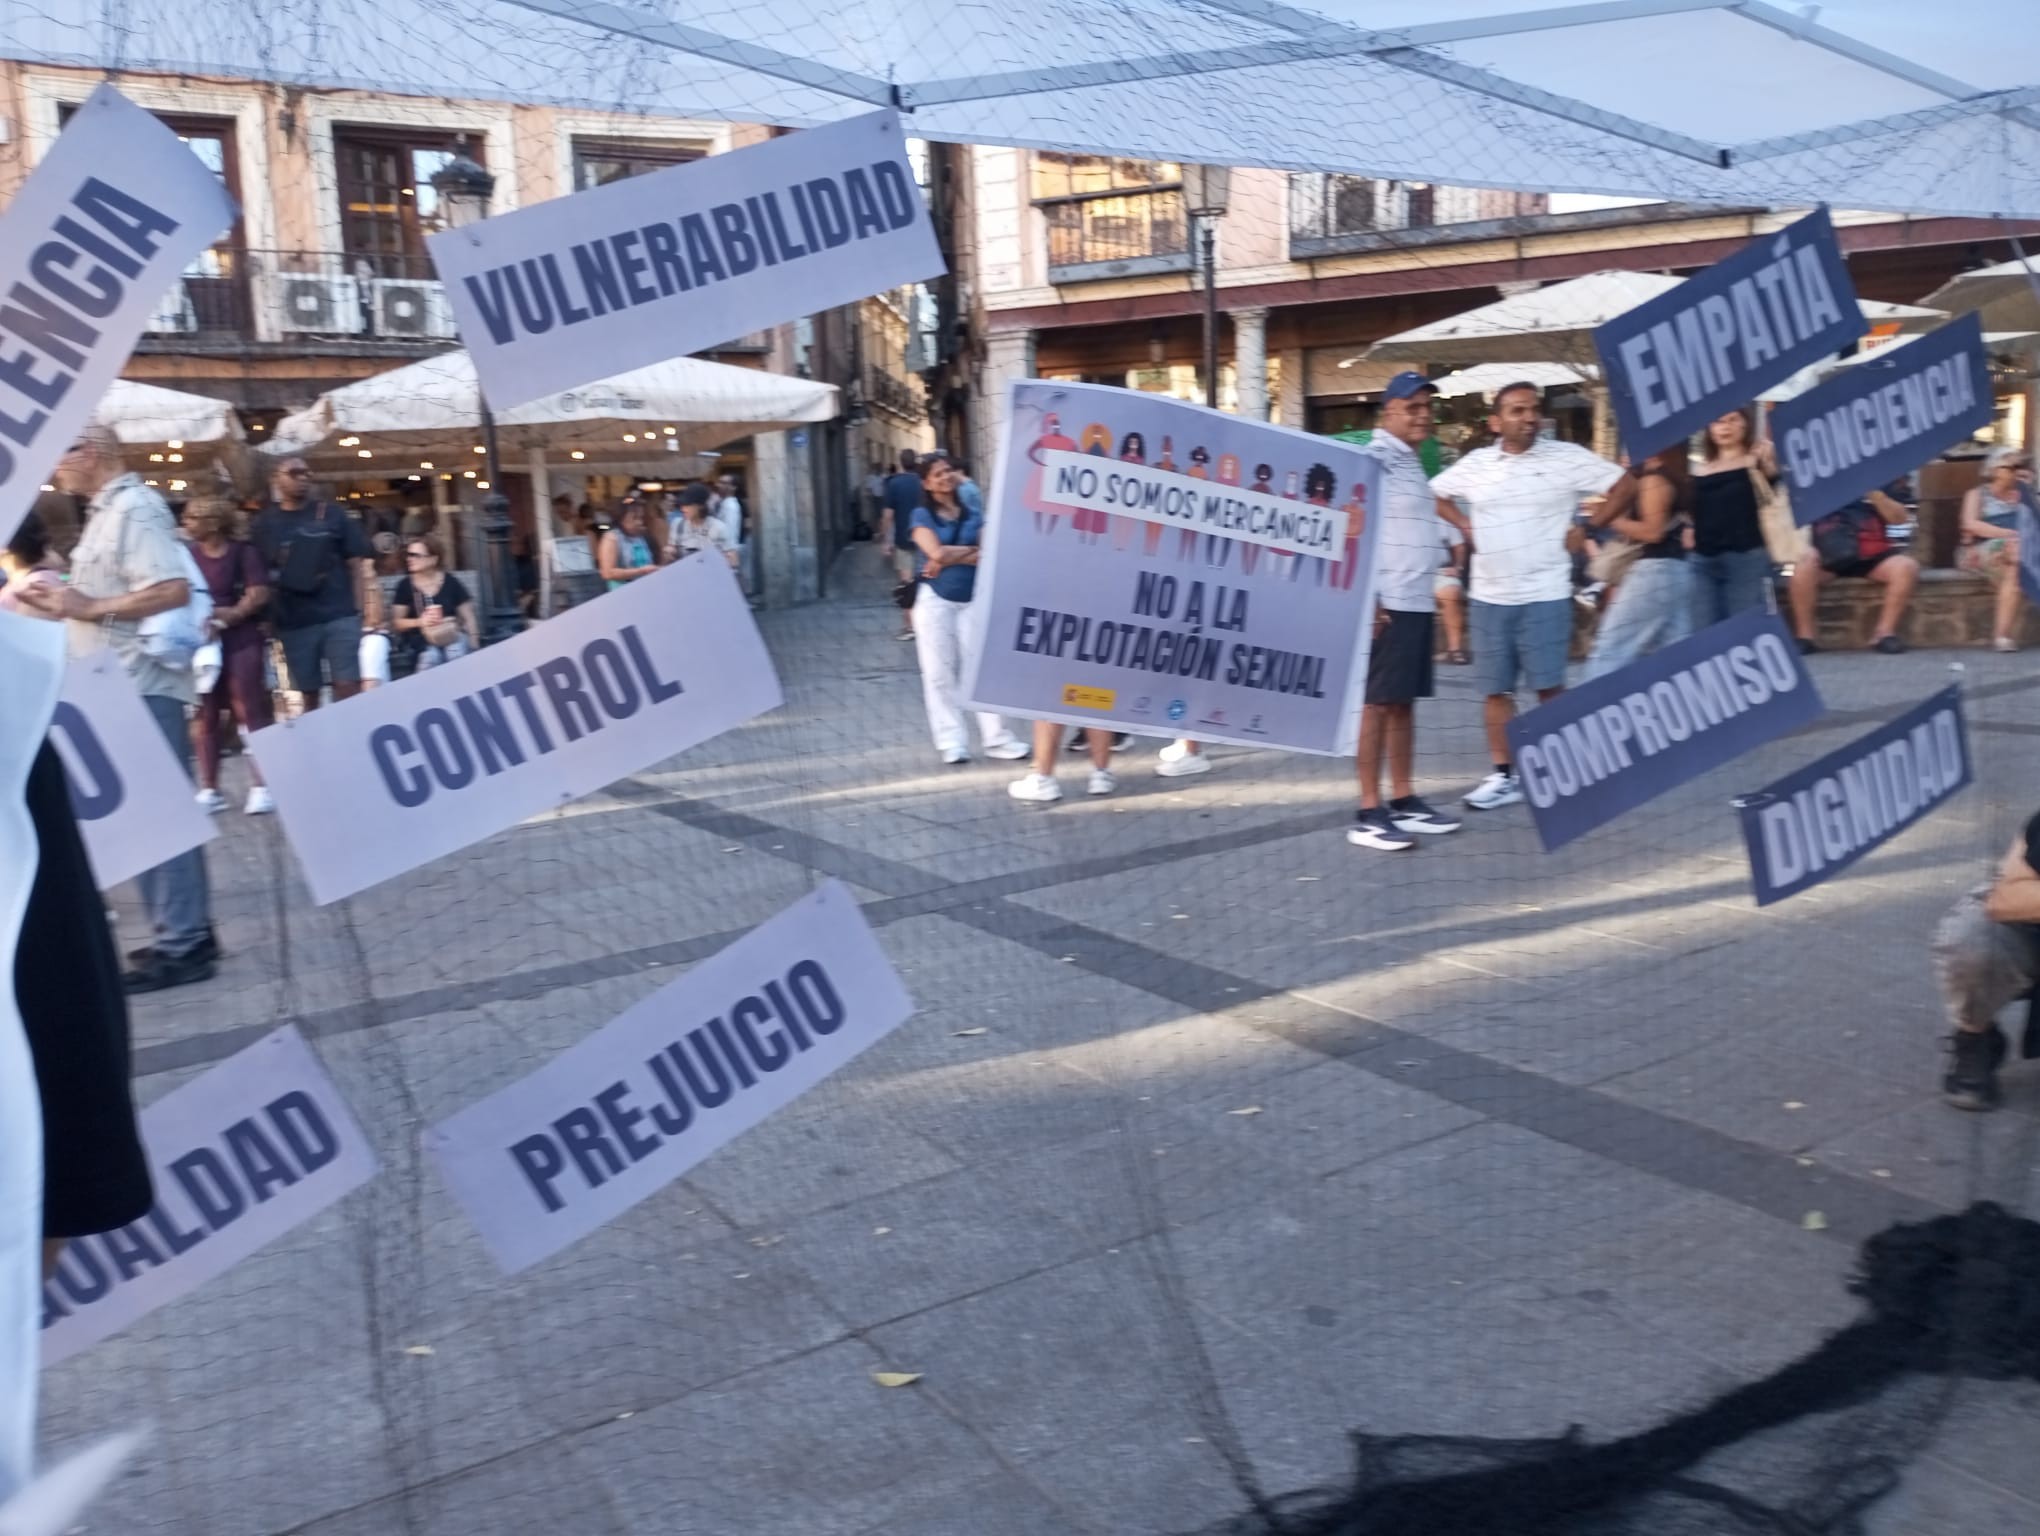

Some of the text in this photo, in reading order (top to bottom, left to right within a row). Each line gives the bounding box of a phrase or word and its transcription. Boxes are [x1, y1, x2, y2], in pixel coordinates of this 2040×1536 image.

[0, 176, 183, 487] LENCIA
[463, 159, 915, 345] VULNERABILIDAD
[1618, 234, 1842, 429] EMPATÍA
[1056, 465, 1334, 551] NO SOMOS MERCANCÍA
[1784, 352, 1977, 488] CONCIENCIA
[1014, 606, 1326, 699] EXPLOTACIÓN SEXUAL
[1131, 570, 1249, 632] NO A LA
[369, 625, 685, 808] CONTROL
[1517, 633, 1798, 809] COMPROMISO
[1758, 709, 1964, 888] DIGNIDAD
[508, 958, 848, 1213] PREJUICIO
